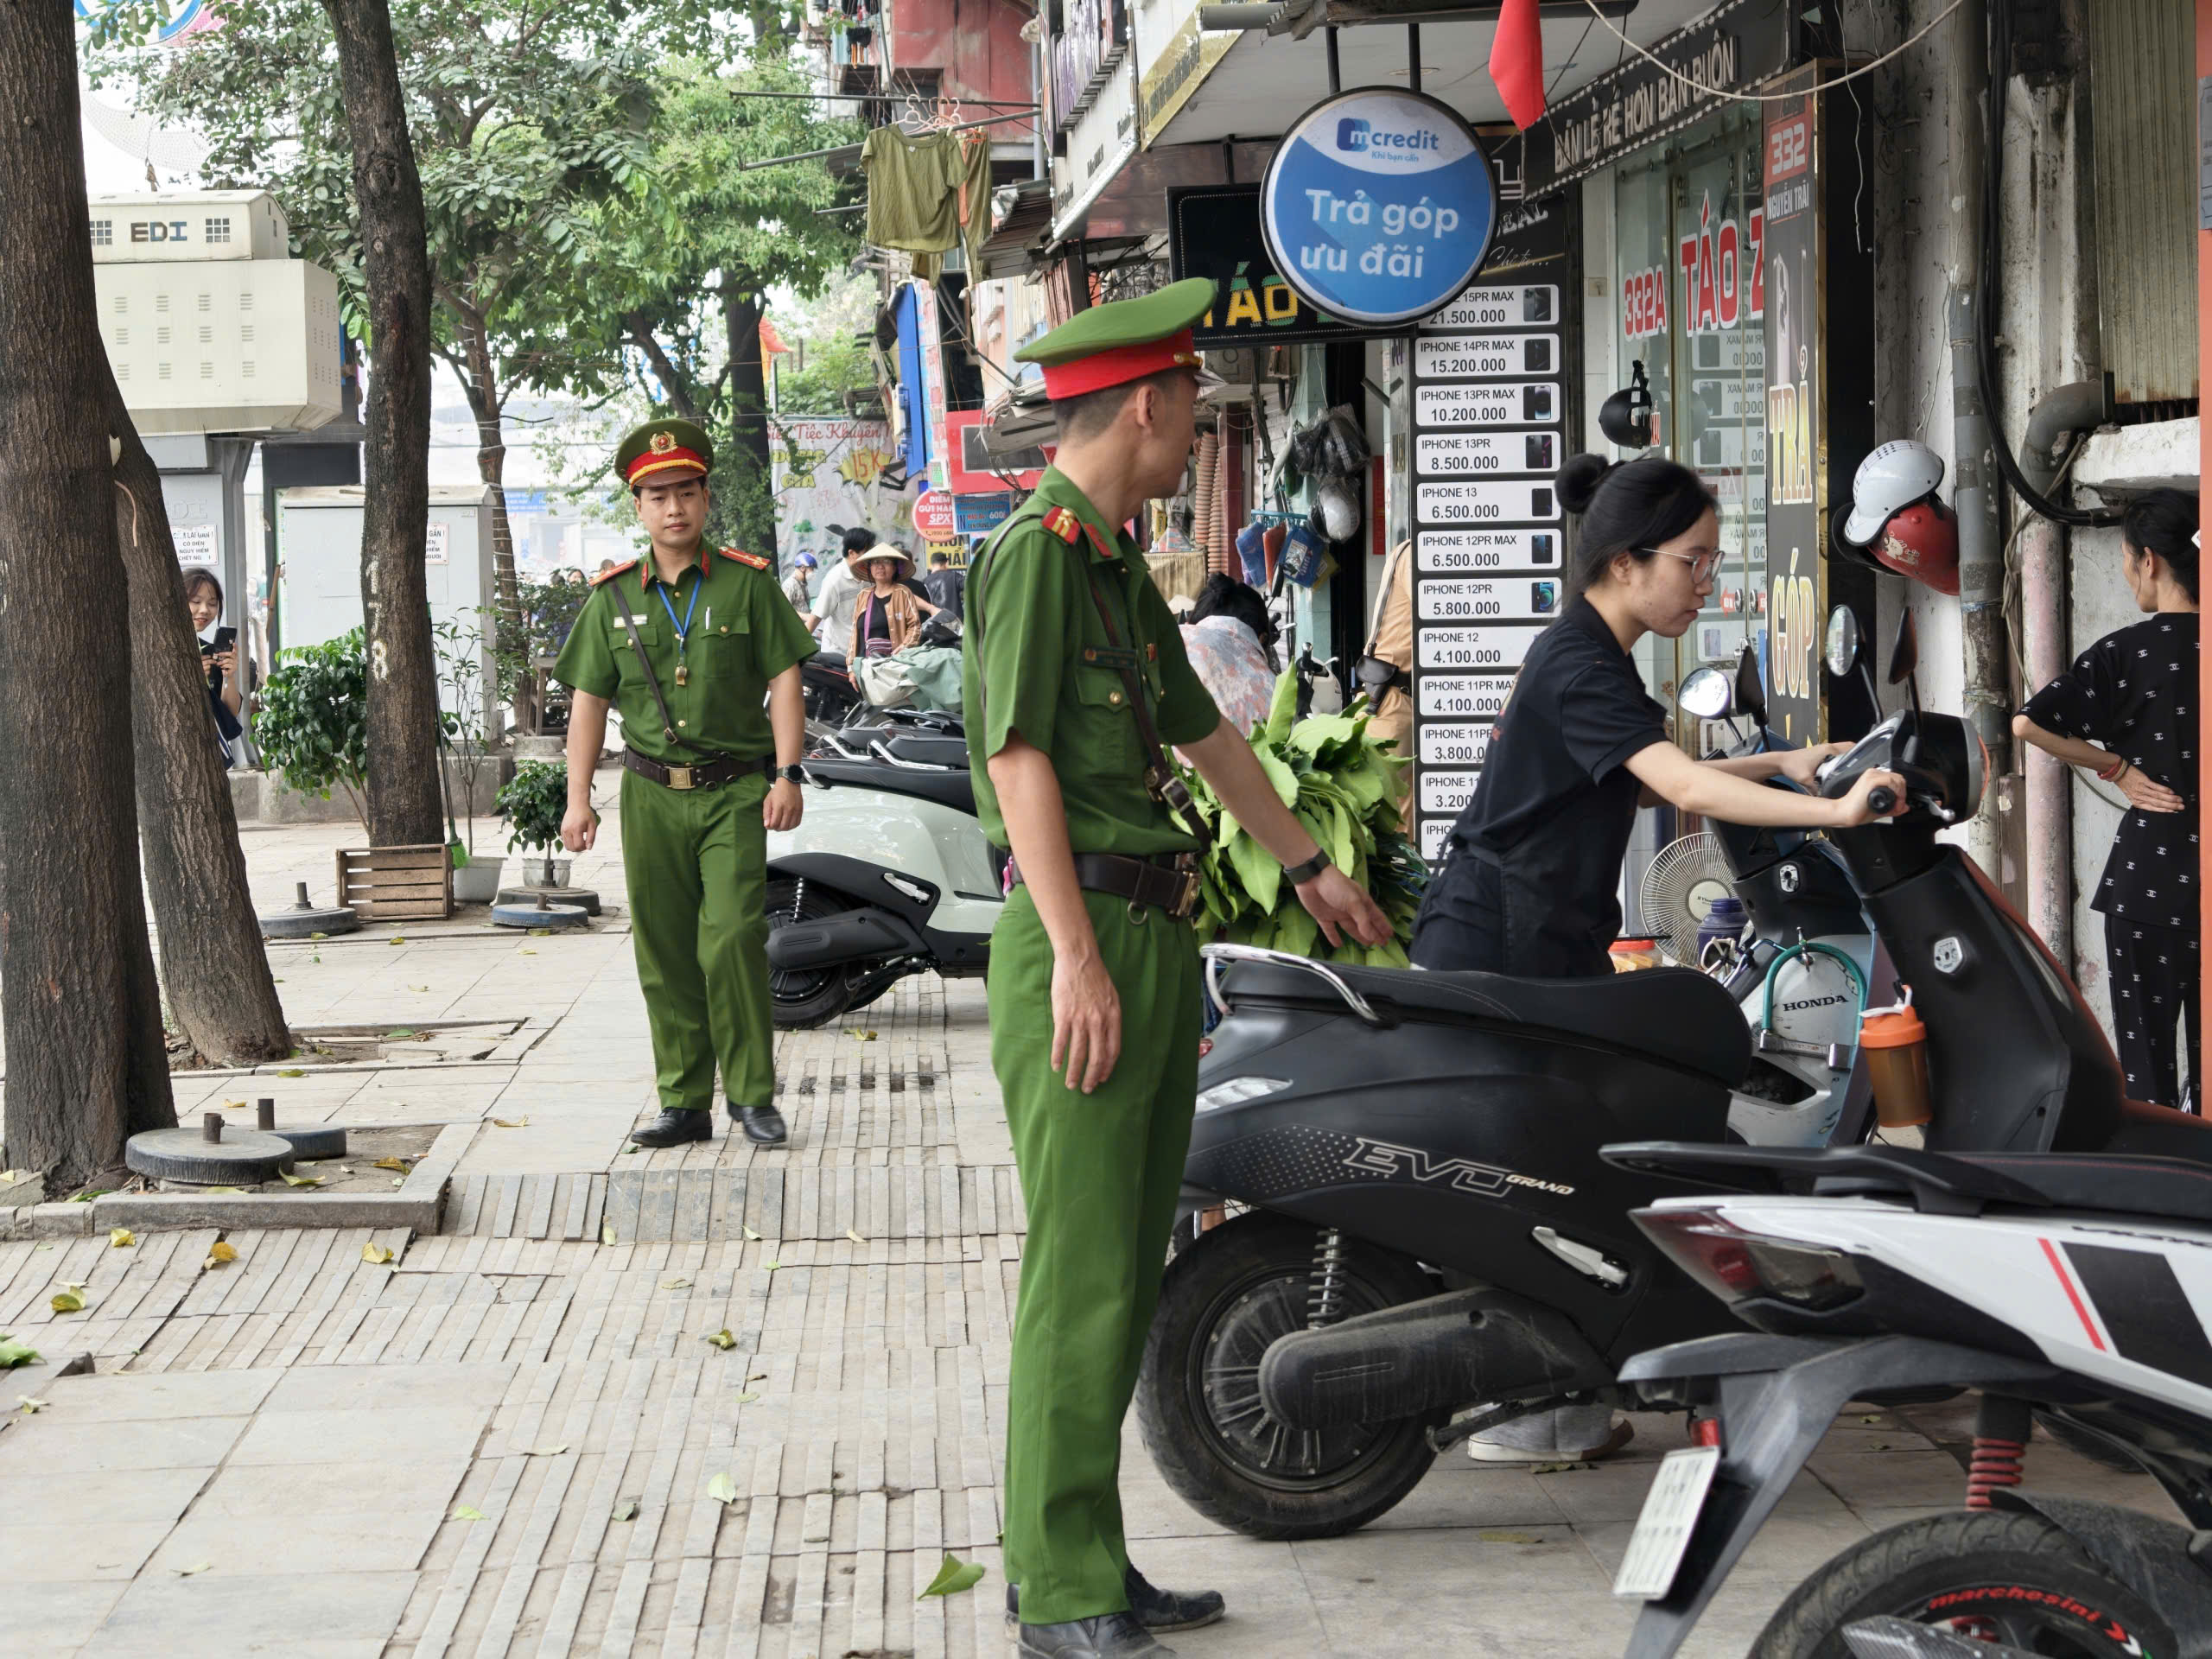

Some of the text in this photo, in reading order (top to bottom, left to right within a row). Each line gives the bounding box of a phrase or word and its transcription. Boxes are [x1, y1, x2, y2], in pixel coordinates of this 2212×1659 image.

[1658, 59, 1690, 121] BÁN
[1693, 29, 1737, 103] BUÔN
[1772, 123, 1806, 175] 332
[1371, 151, 1386, 160] Khi
[1387, 152, 1403, 162] bạn
[1306, 188, 1459, 238] Trả góp
[130, 221, 188, 242] EDI
[1300, 243, 1424, 278] ưu đãi
[1681, 188, 1738, 338] TÁO
[1204, 261, 1298, 328] ÁO
[1464, 292, 1490, 302] 15PR
[1491, 291, 1515, 302] MAX
[1624, 264, 1667, 342] 332A
[1429, 309, 1506, 325] 21.500.000
[1421, 340, 1515, 353] IPHONE 14PR MAX
[1430, 359, 1506, 373] 15.200.000
[1421, 389, 1516, 401] IPHONE 13PR MAX
[1431, 407, 1507, 422] 10.200.000
[1769, 345, 1813, 505] TRẢ
[1421, 439, 1491, 449] IPHONE 13PR
[1431, 456, 1499, 470] 8.500.000
[1422, 487, 1478, 498] IPHONE 13
[929, 513, 950, 524] SPX
[1432, 505, 1499, 518] 6.500.000
[1423, 535, 1517, 546] IPHONE 12PR MAX
[1432, 553, 1500, 567] 6.500.000
[1424, 584, 1492, 594] IPHONE 12PR
[1433, 601, 1500, 615] 5.800.000
[1772, 548, 1815, 699] GÓP
[1424, 632, 1478, 643] IPHONE 12
[1433, 650, 1501, 664] 4.100.000
[1425, 681, 1465, 690] IPHONE
[1467, 681, 1493, 690] 11PR
[1433, 698, 1502, 712] 4.100.000
[1426, 729, 1465, 740] IPHONE
[1426, 778, 1465, 787] IPHONE
[1783, 995, 1848, 1011] HONDA
[1343, 1137, 1575, 1198] EVO GRAND
[1929, 1586, 2101, 1623] marchesini
